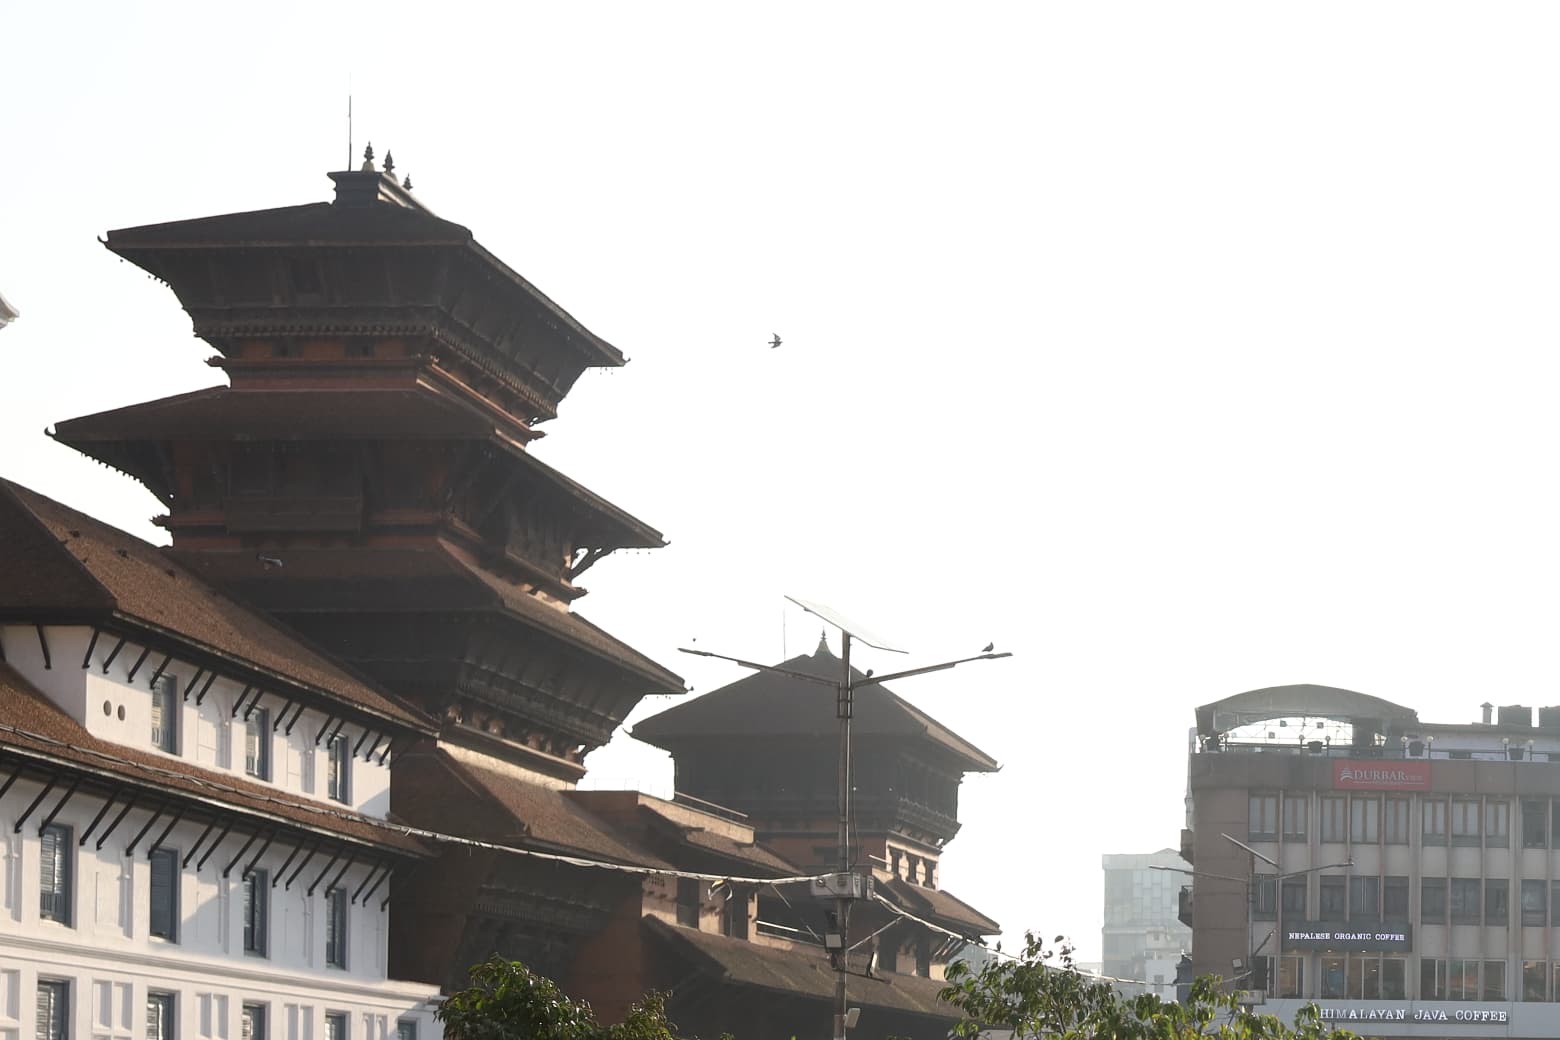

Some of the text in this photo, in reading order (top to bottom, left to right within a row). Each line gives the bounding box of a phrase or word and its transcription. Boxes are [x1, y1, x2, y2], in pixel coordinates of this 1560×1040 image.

[1354, 769, 1406, 781] DURBAR
[1288, 932, 1405, 942] NEPALESE ORGANIC COFFEE
[1319, 1008, 1507, 1022] HIMALAYAN JAVA COFFEE
